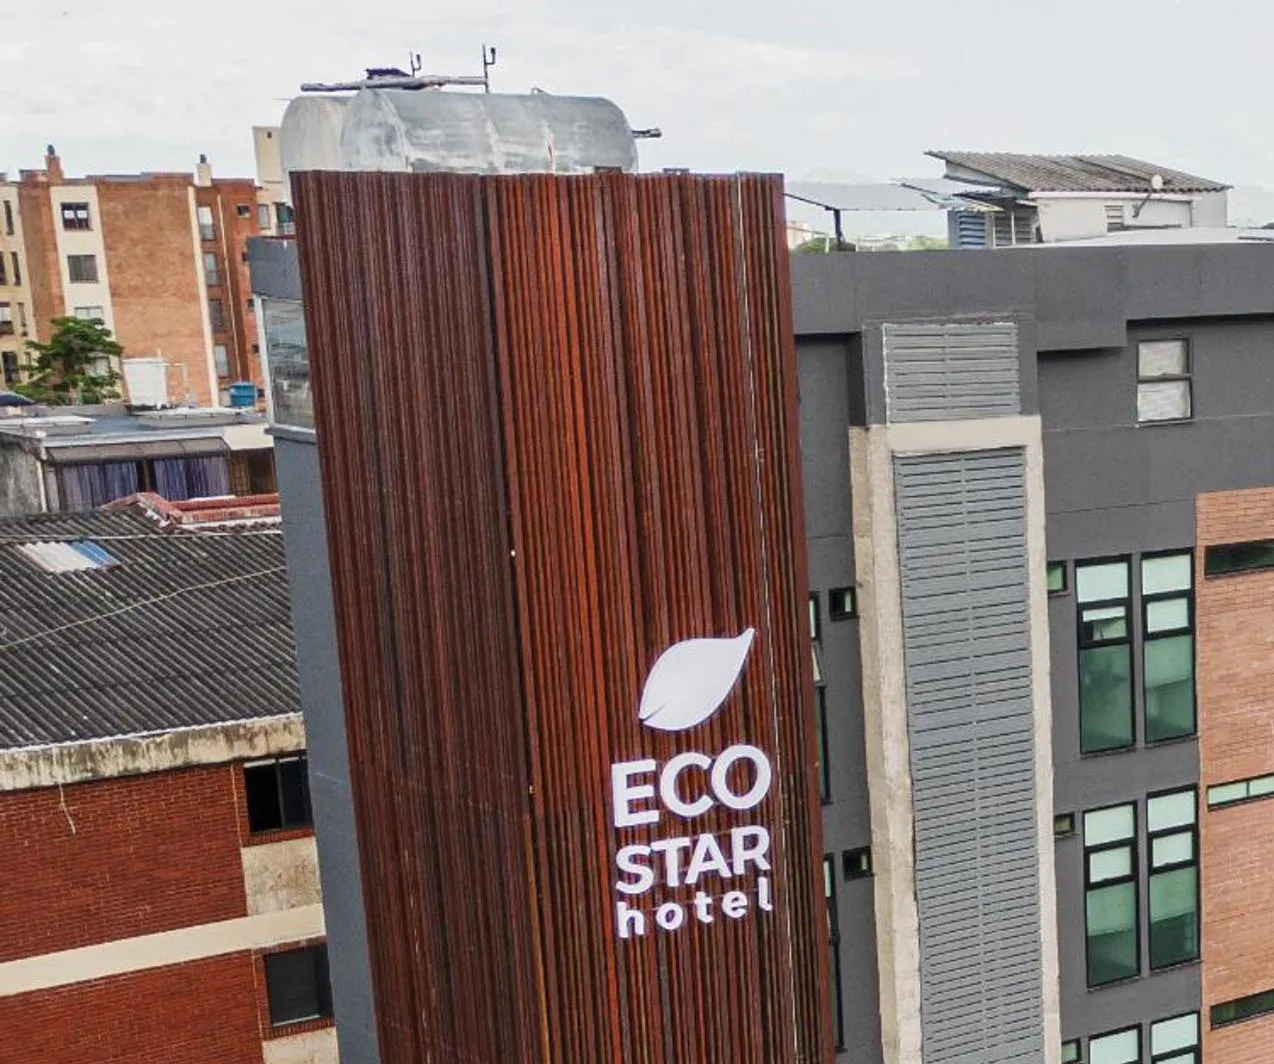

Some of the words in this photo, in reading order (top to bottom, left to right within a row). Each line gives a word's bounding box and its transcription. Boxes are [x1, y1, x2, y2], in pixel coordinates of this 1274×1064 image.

[611, 744, 772, 828] ECO
[615, 824, 772, 895] STAR
[615, 876, 773, 939] hotel
